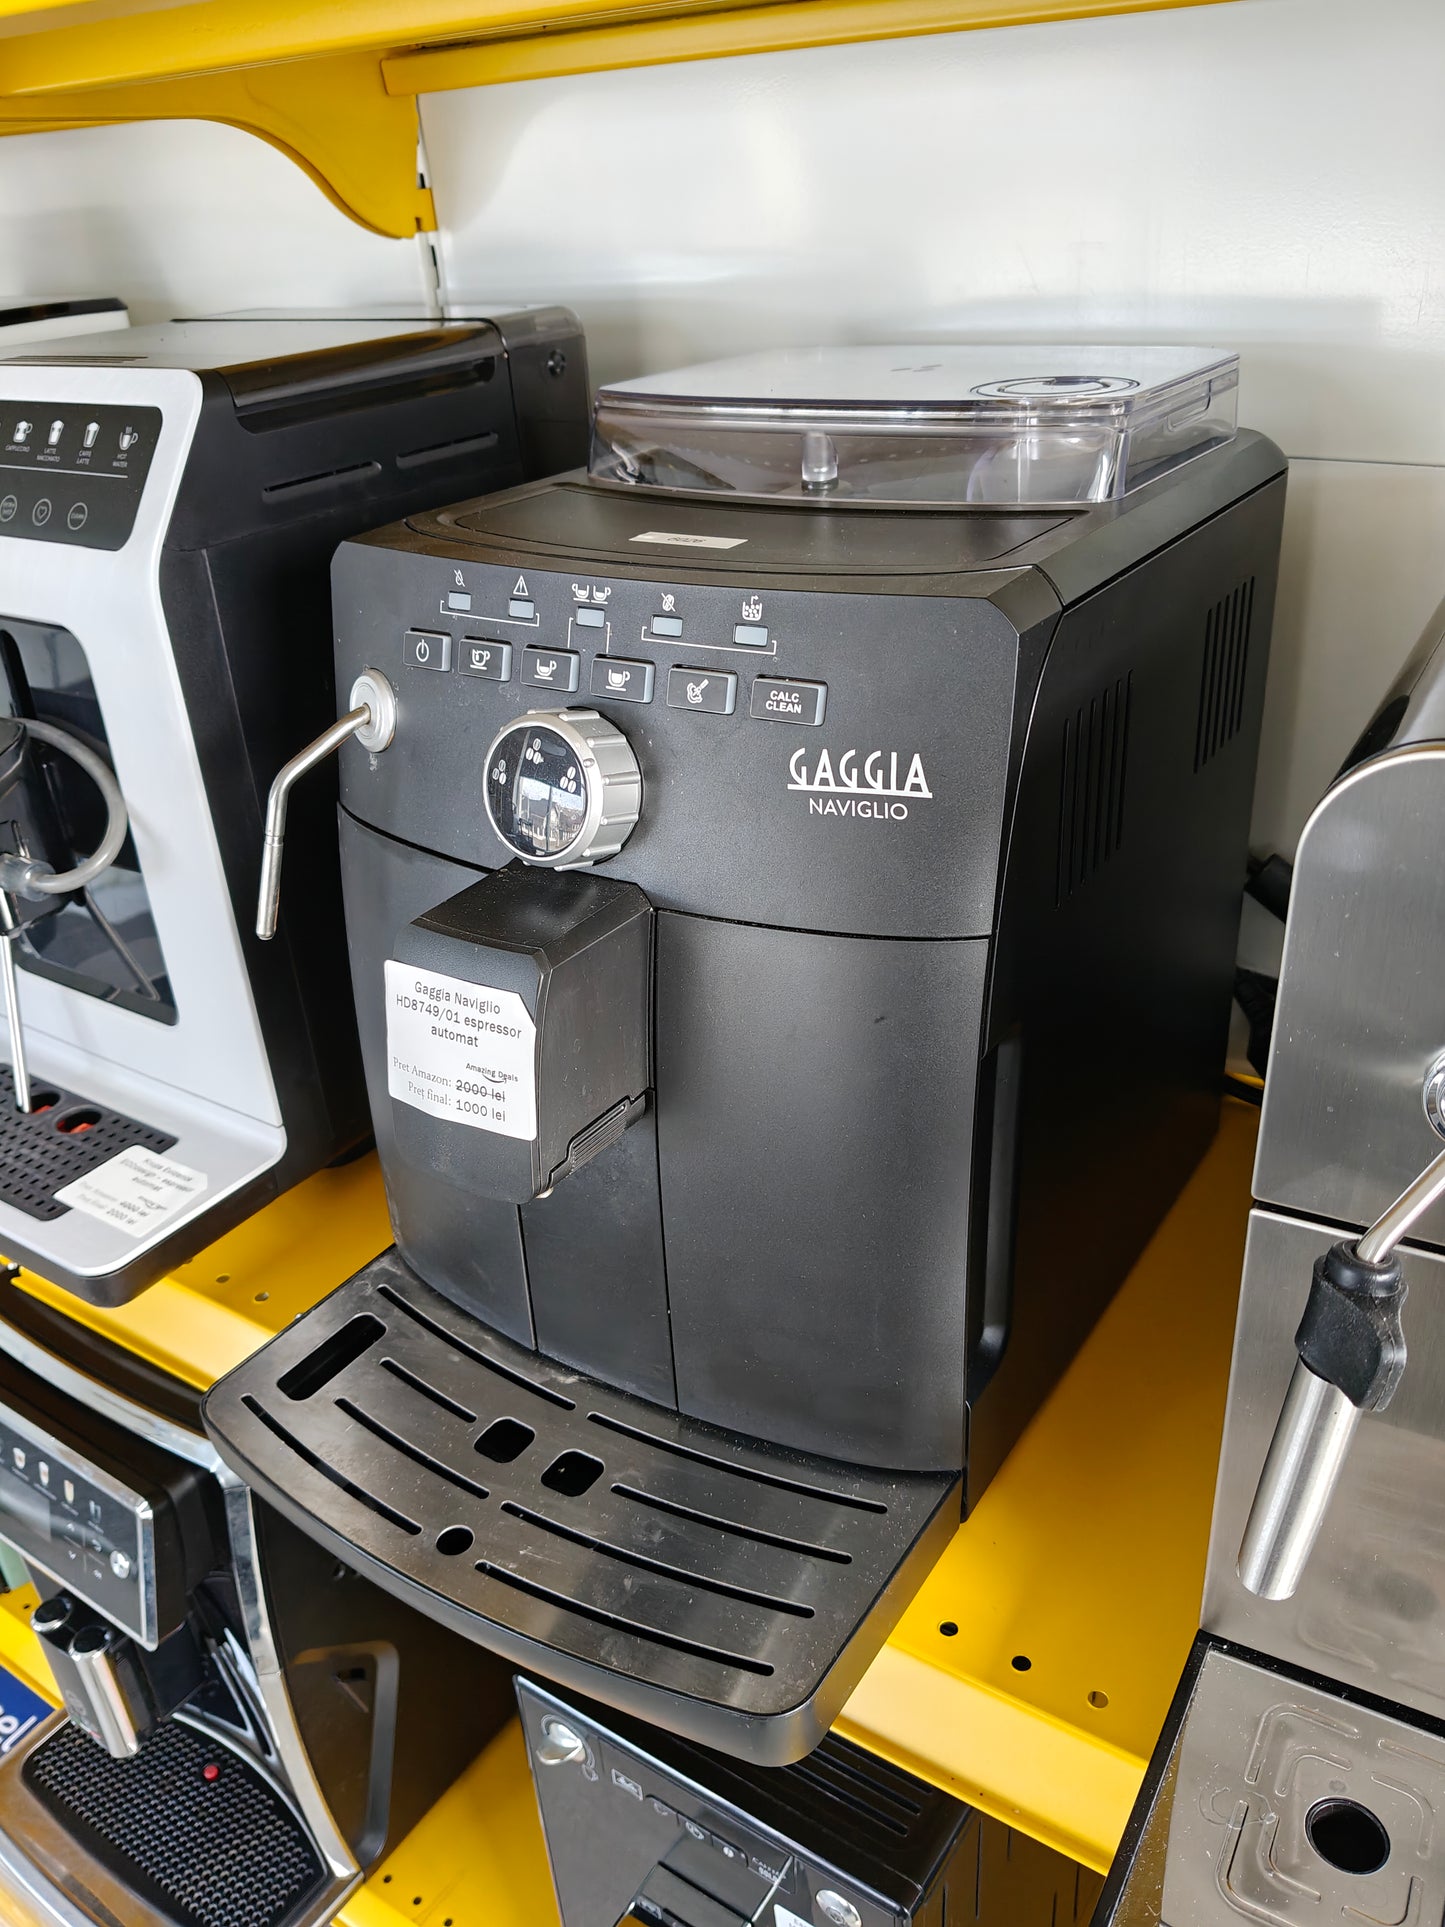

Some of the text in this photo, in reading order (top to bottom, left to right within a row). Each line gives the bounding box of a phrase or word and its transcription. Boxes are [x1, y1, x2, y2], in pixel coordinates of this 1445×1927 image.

[765, 700, 802, 714] CLEAN
[770, 690, 800, 703] CALC
[788, 747, 933, 798] GAGGIA
[809, 798, 908, 820] NAVIGLIO
[414, 981, 501, 1015] Gaggia Naviglio
[396, 994, 522, 1039] HD8749/01 espressor
[430, 1025, 479, 1047] automat
[411, 1065, 452, 1088] Amazon:
[455, 1079, 488, 1097] 2000
[491, 1088, 506, 1103] lei
[466, 1062, 496, 1079] Amazing
[427, 1088, 452, 1107] final:
[456, 1099, 488, 1117] 1000
[491, 1107, 506, 1122] lei
